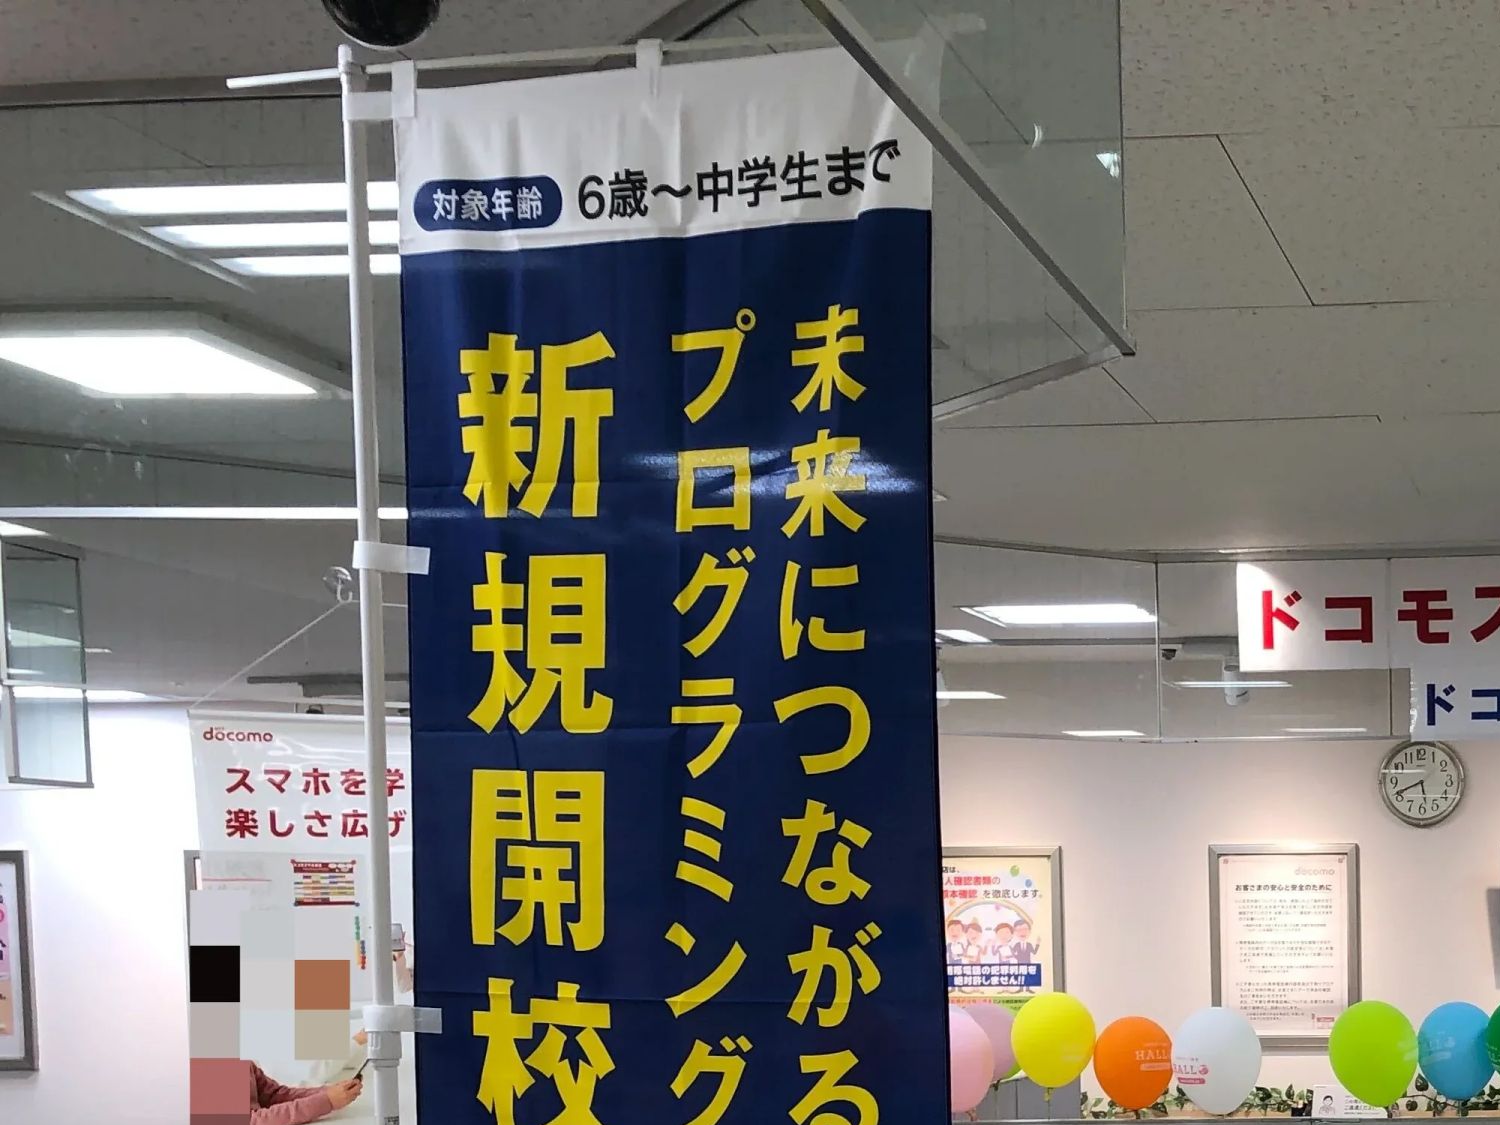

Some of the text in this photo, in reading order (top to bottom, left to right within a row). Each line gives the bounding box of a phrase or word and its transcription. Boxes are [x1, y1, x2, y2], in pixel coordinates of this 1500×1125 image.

[432, 185, 543, 223] 対象年齢
[203, 727, 273, 742] docomo
[1235, 884, 1332, 892] お客さまの安心と安全のために
